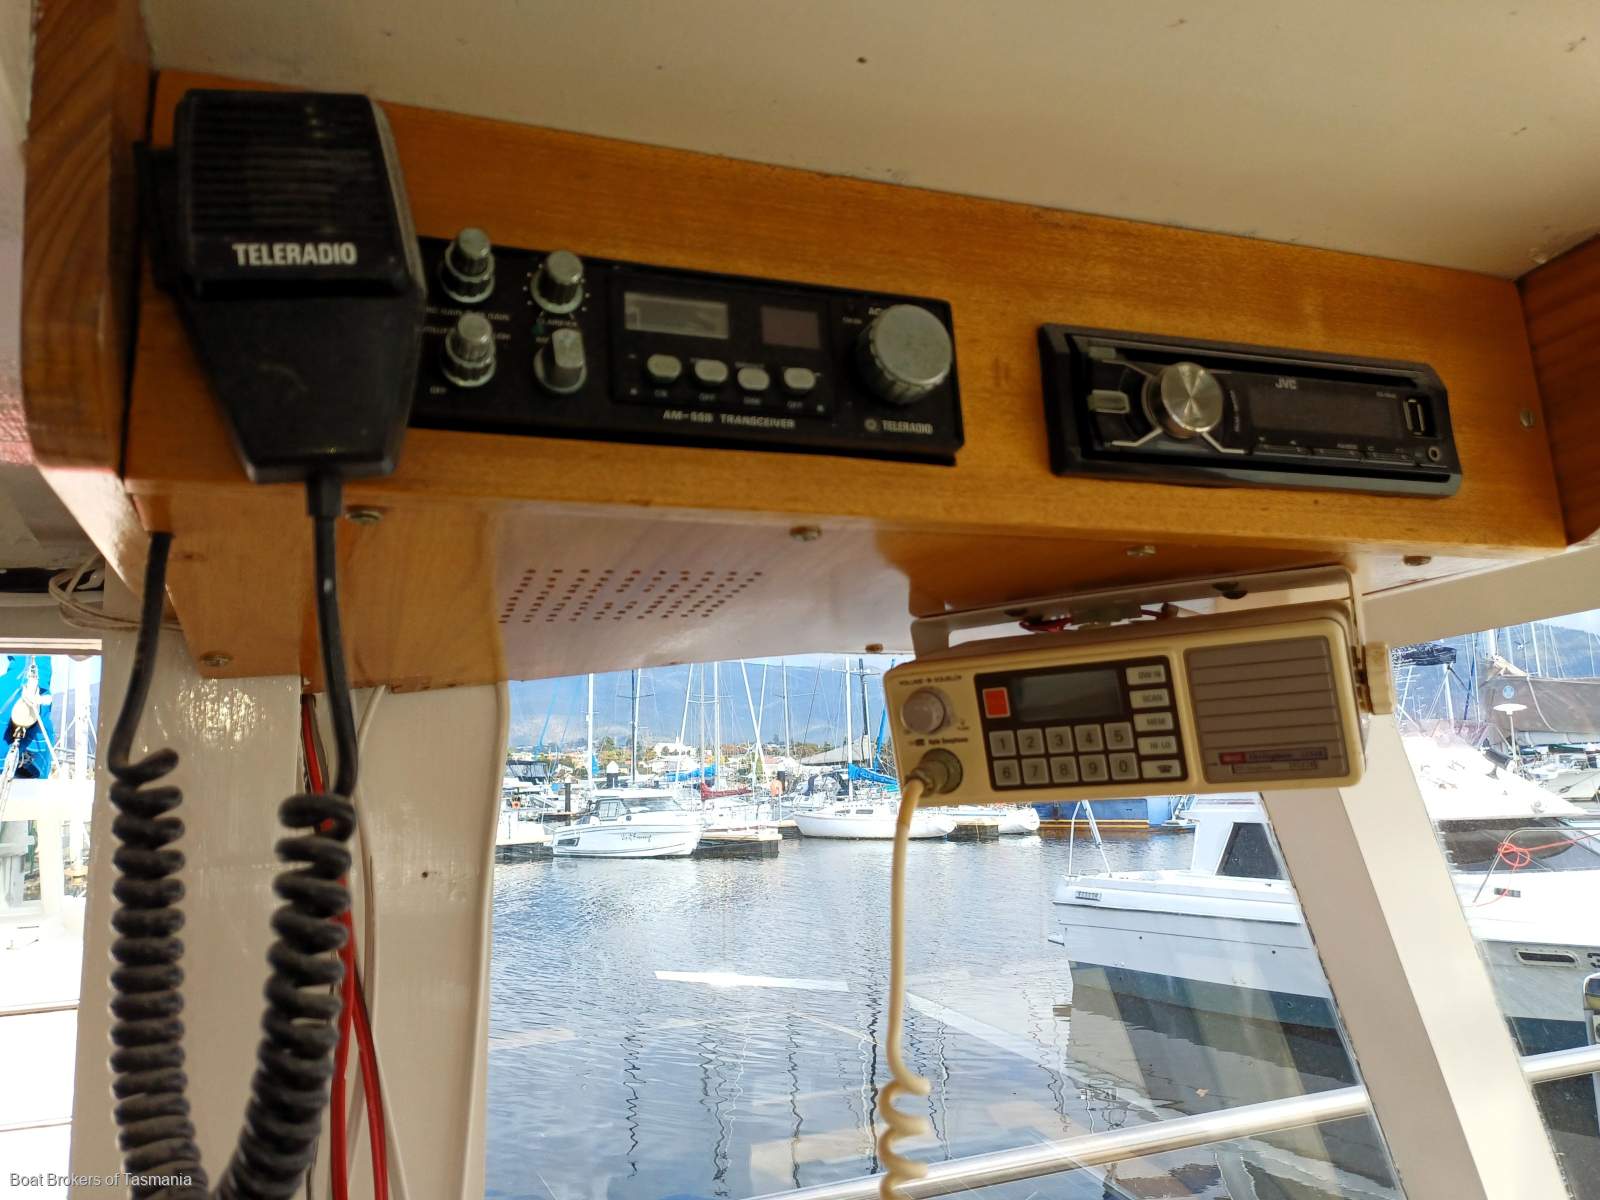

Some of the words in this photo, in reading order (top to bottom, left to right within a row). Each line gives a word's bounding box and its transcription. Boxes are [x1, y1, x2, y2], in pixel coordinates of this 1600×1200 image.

[231, 242, 357, 266] TELERADIO
[1275, 377, 1297, 390] JVC
[719, 413, 796, 429] TRANSCEIVER
[881, 420, 934, 434] TELERADIO
[1000, 737, 1006, 751] 1
[1025, 736, 1035, 749] 2
[1054, 734, 1064, 747] 3
[1085, 732, 1093, 745] 4
[1113, 730, 1124, 743] 5
[1002, 767, 1011, 779] 6
[1032, 765, 1040, 777] 7
[1059, 763, 1069, 777] 8
[1088, 761, 1098, 775] 9
[1118, 759, 1129, 773] 0
